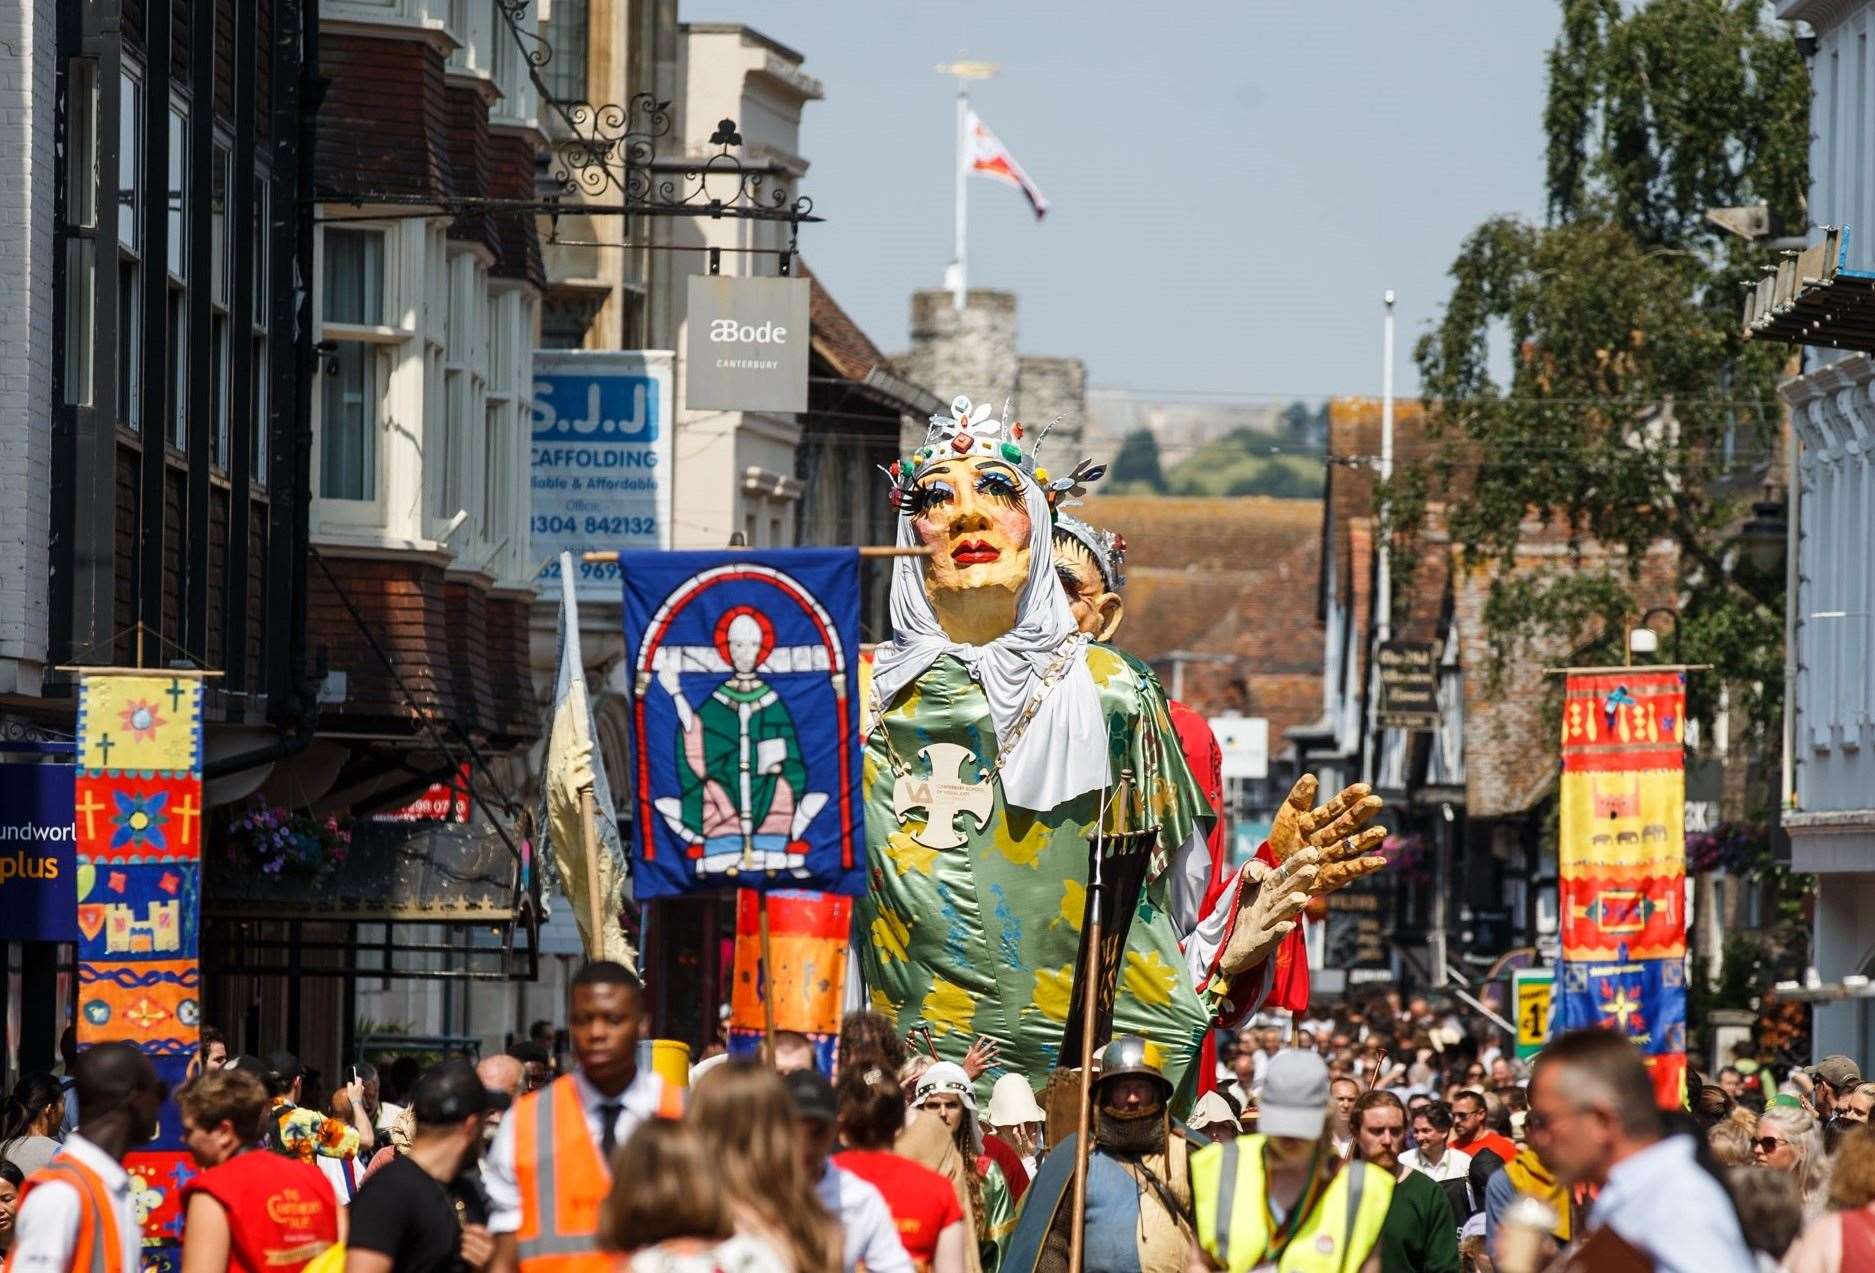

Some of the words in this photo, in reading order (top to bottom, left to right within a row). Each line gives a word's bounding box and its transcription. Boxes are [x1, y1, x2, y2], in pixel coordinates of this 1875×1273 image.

[716, 359, 779, 369] CANTERBURY
[531, 381, 646, 434] S.J.J
[571, 477, 582, 490] &
[587, 477, 658, 491] Affordable
[584, 516, 656, 535] 842132
[0, 849, 59, 886] plus
